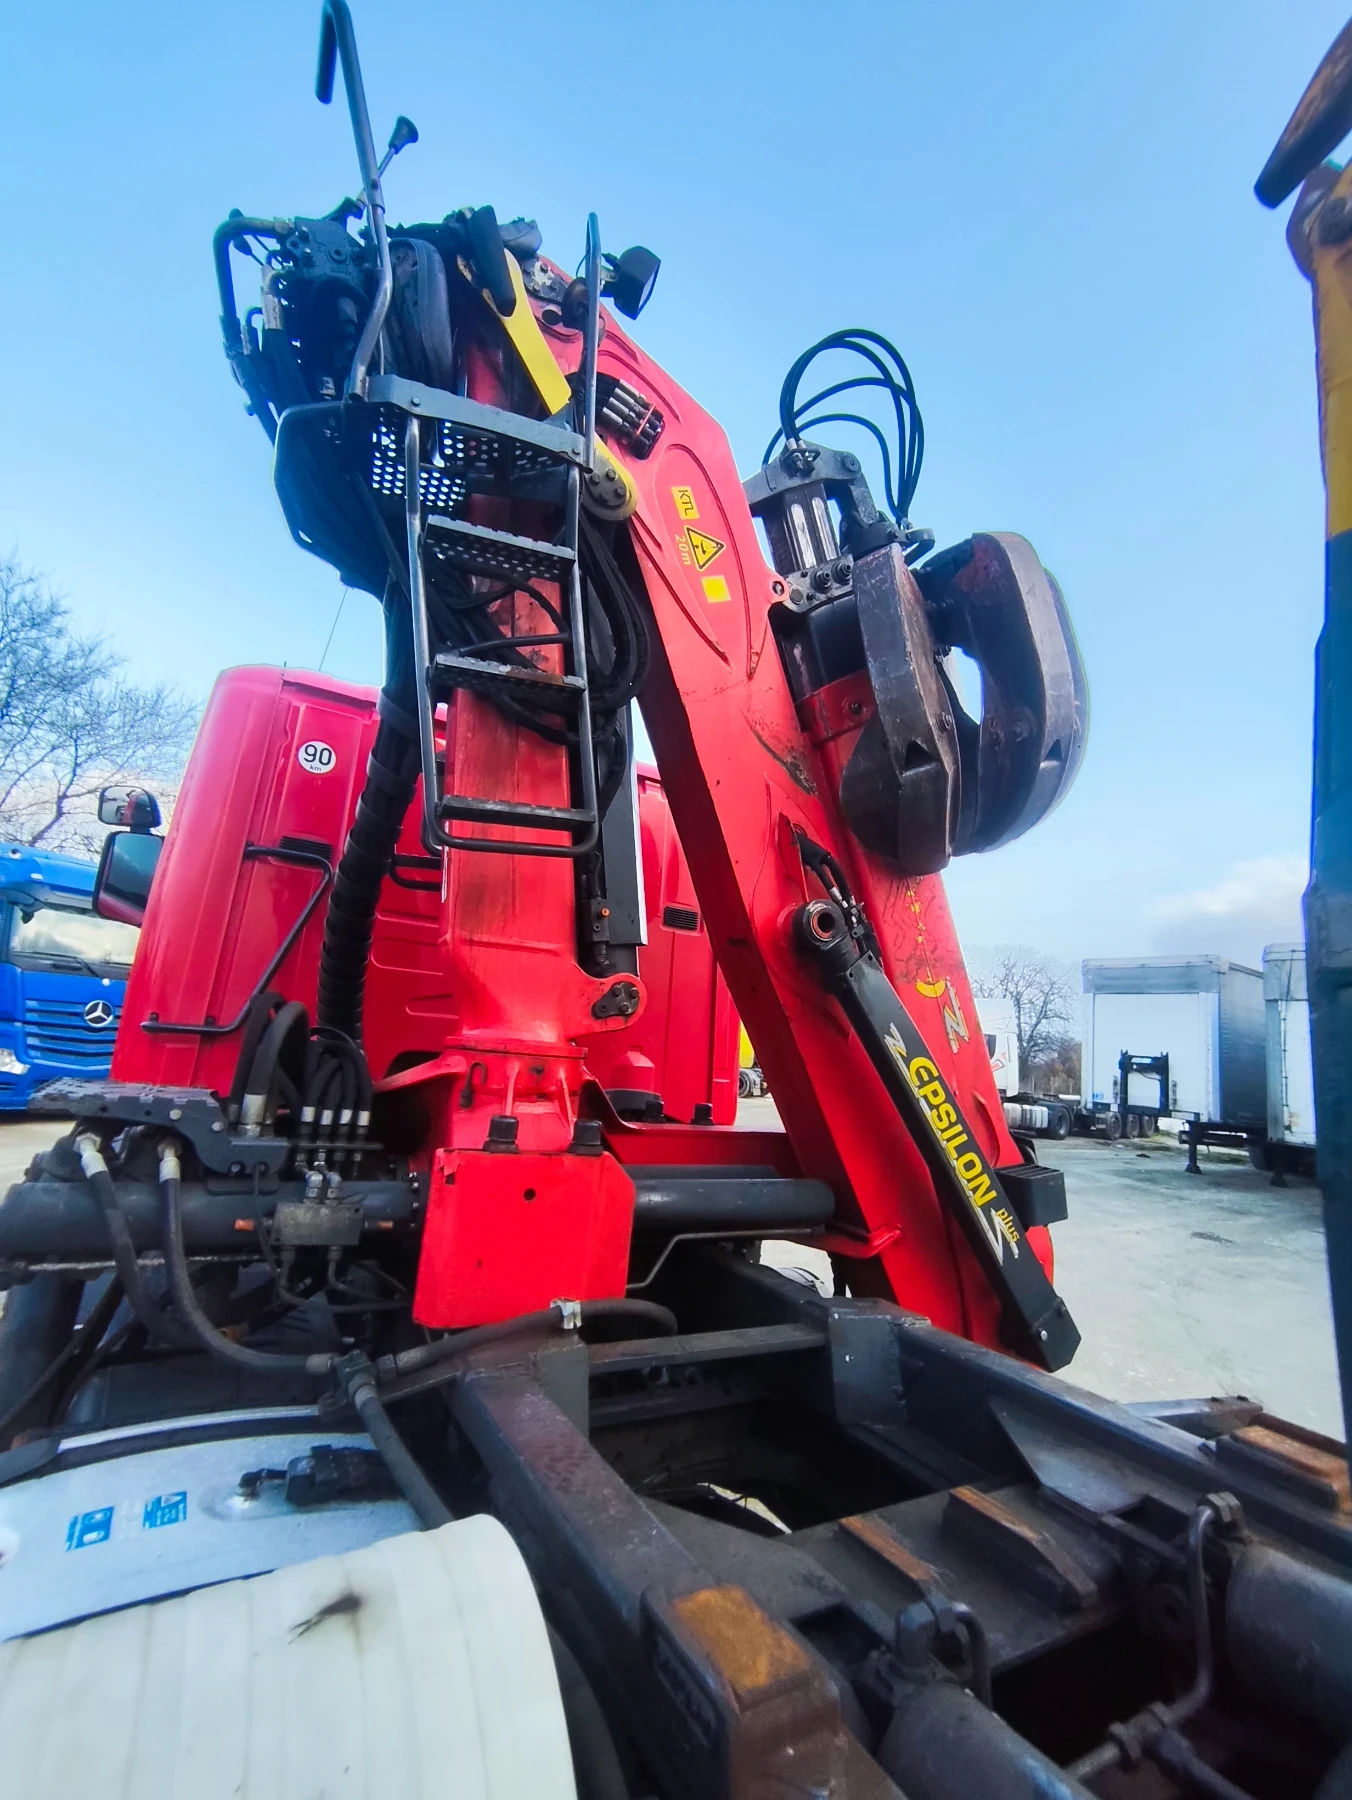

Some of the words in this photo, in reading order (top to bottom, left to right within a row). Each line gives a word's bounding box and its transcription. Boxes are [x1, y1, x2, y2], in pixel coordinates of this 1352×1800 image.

[303, 744, 332, 766] 90
[309, 764, 322, 772] km
[909, 1056, 997, 1207] EPSILON
[995, 1207, 1020, 1242] plus
